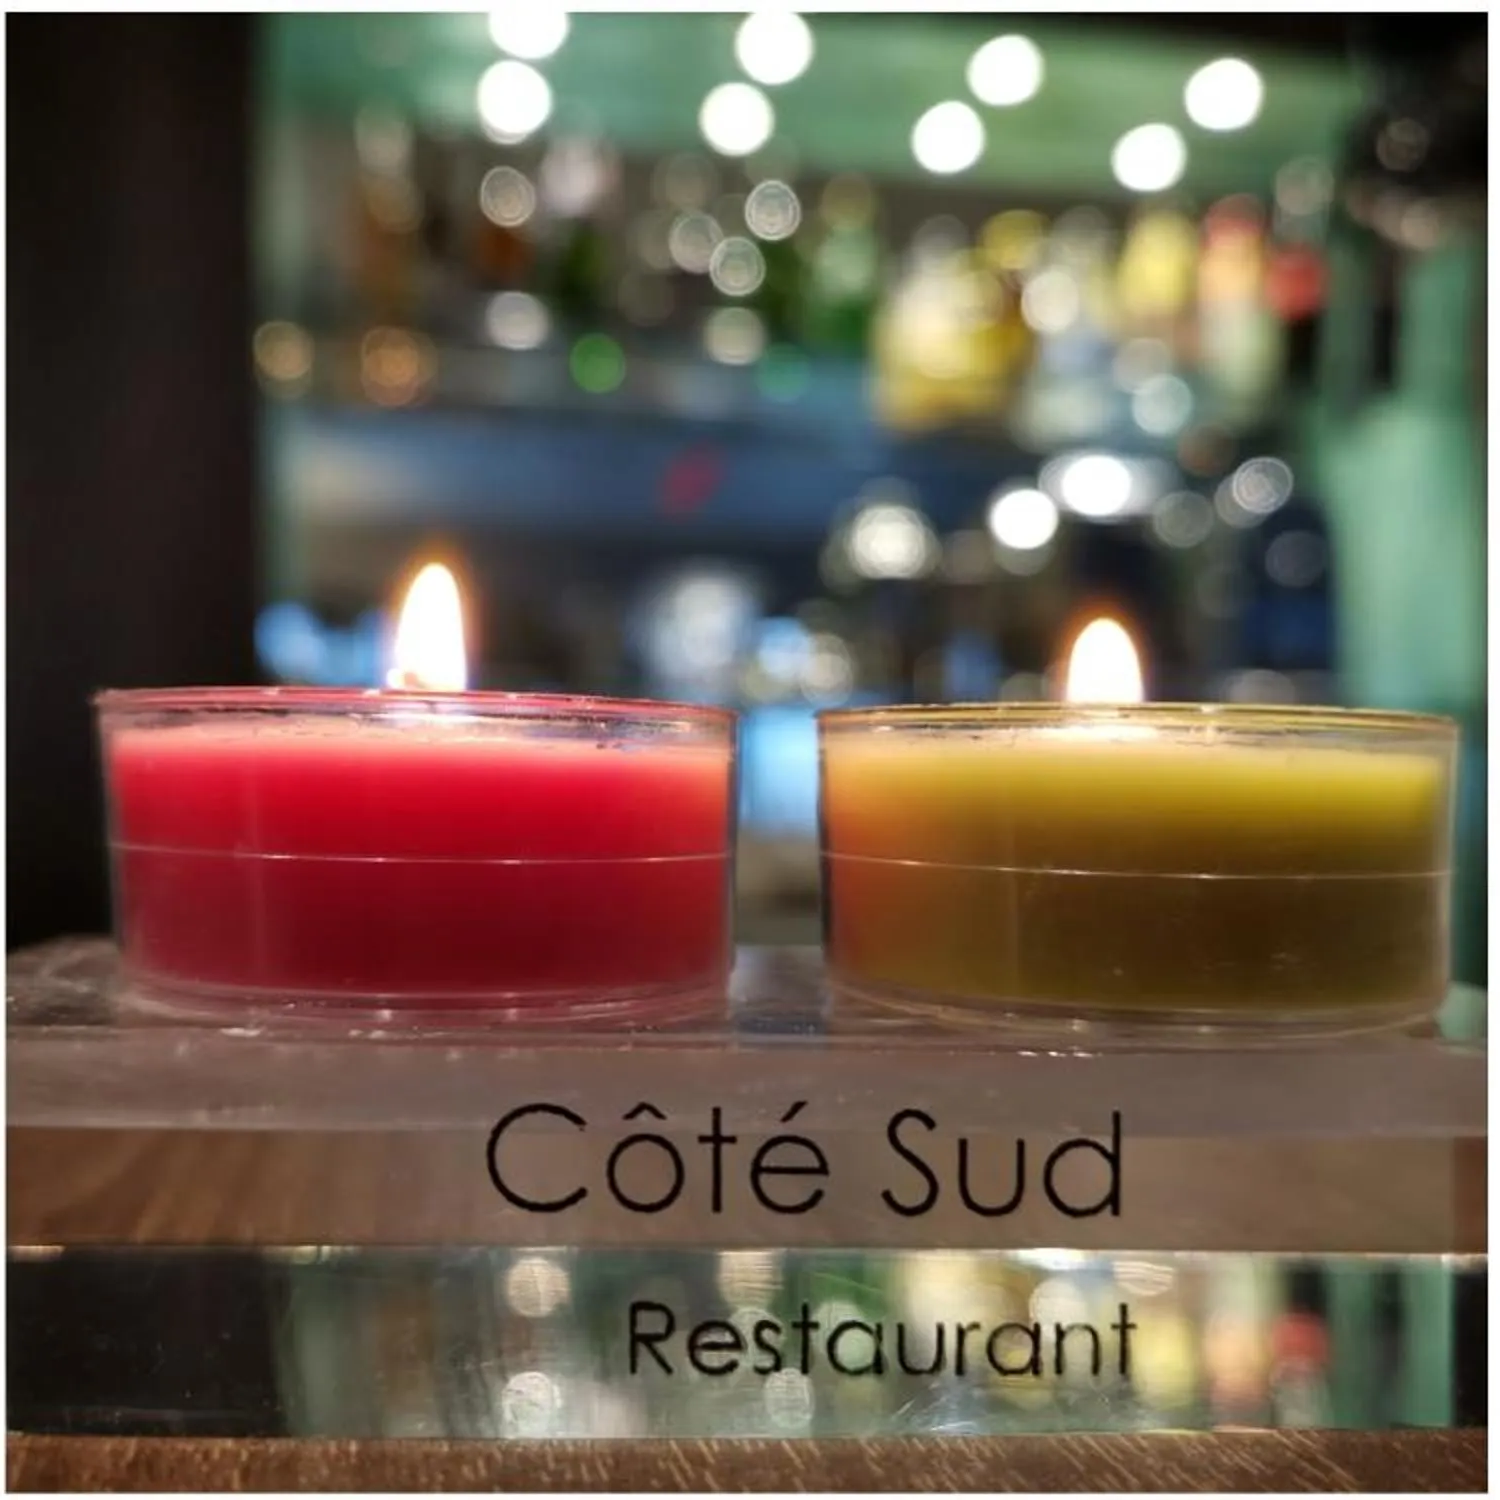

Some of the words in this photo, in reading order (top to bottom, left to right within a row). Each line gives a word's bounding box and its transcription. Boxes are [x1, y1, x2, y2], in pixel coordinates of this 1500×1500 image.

[486, 1100, 830, 1214] Côté
[881, 1108, 1122, 1218] Sud
[627, 1300, 1138, 1378] Restaurant
